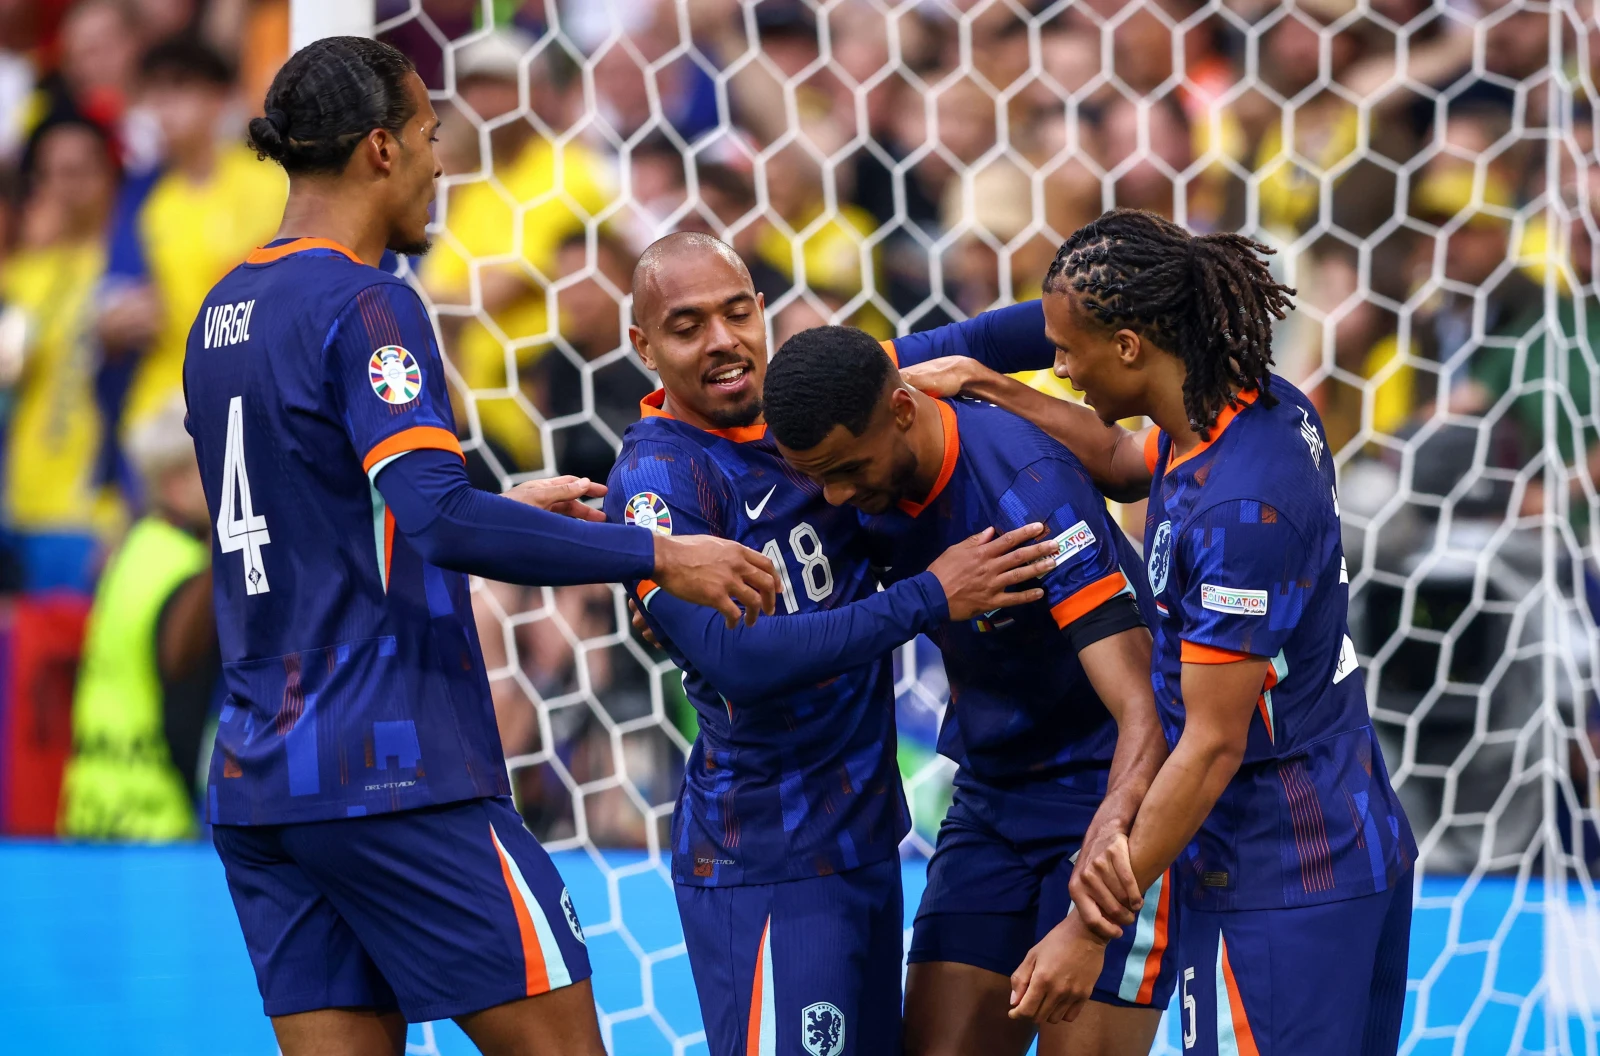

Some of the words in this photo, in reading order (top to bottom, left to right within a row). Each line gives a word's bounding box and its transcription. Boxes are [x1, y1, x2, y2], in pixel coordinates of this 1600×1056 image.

[204, 299, 256, 349] VIRGIL
[216, 395, 272, 596] 4
[761, 521, 834, 614] 18
[1183, 966, 1197, 1050] 5
